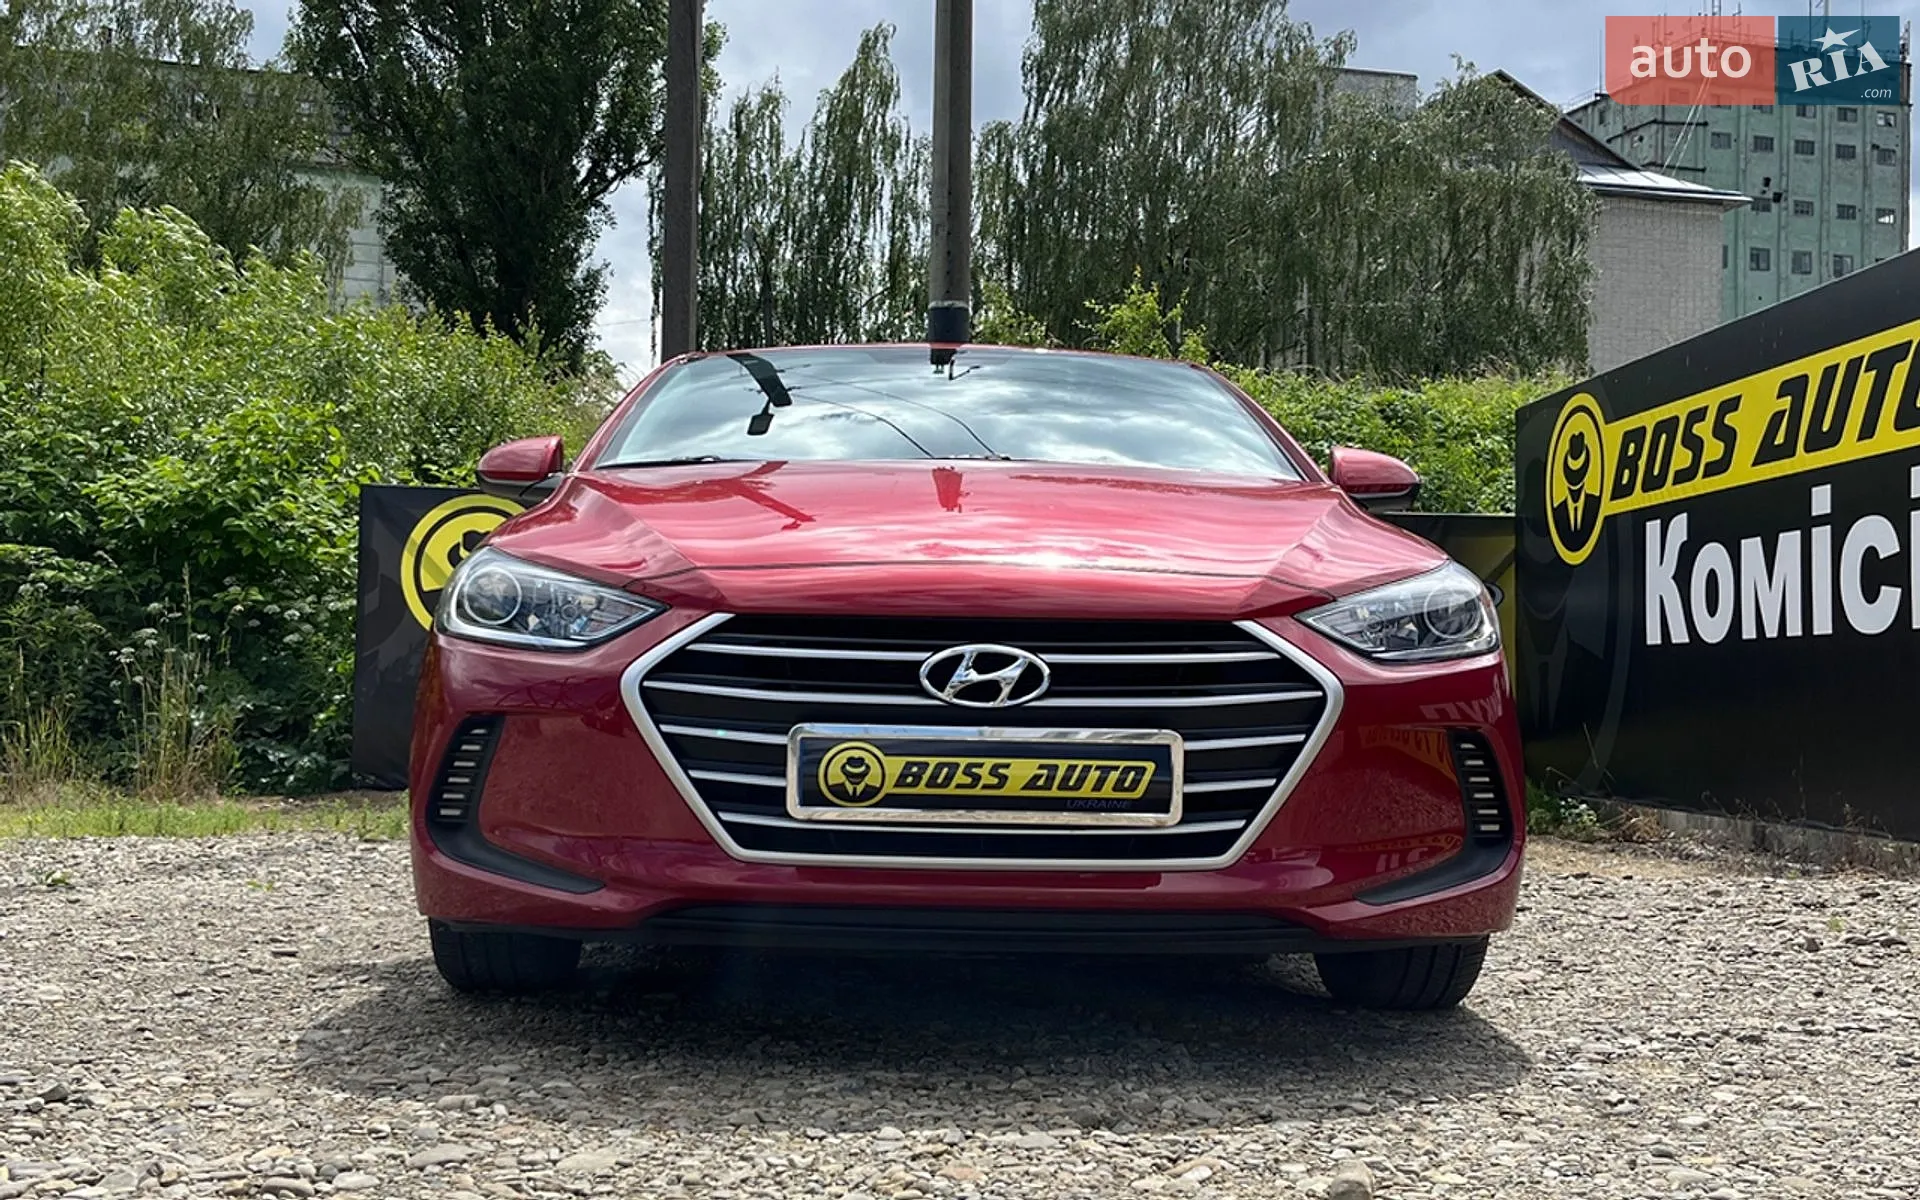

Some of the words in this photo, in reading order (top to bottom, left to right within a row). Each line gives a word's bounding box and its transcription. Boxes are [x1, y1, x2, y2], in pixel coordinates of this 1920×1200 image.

[1610, 394, 1743, 502] BOSS
[894, 762, 1011, 789] BOSS
[1021, 763, 1148, 792] AUTO
[1066, 799, 1132, 810] UKRAINE
